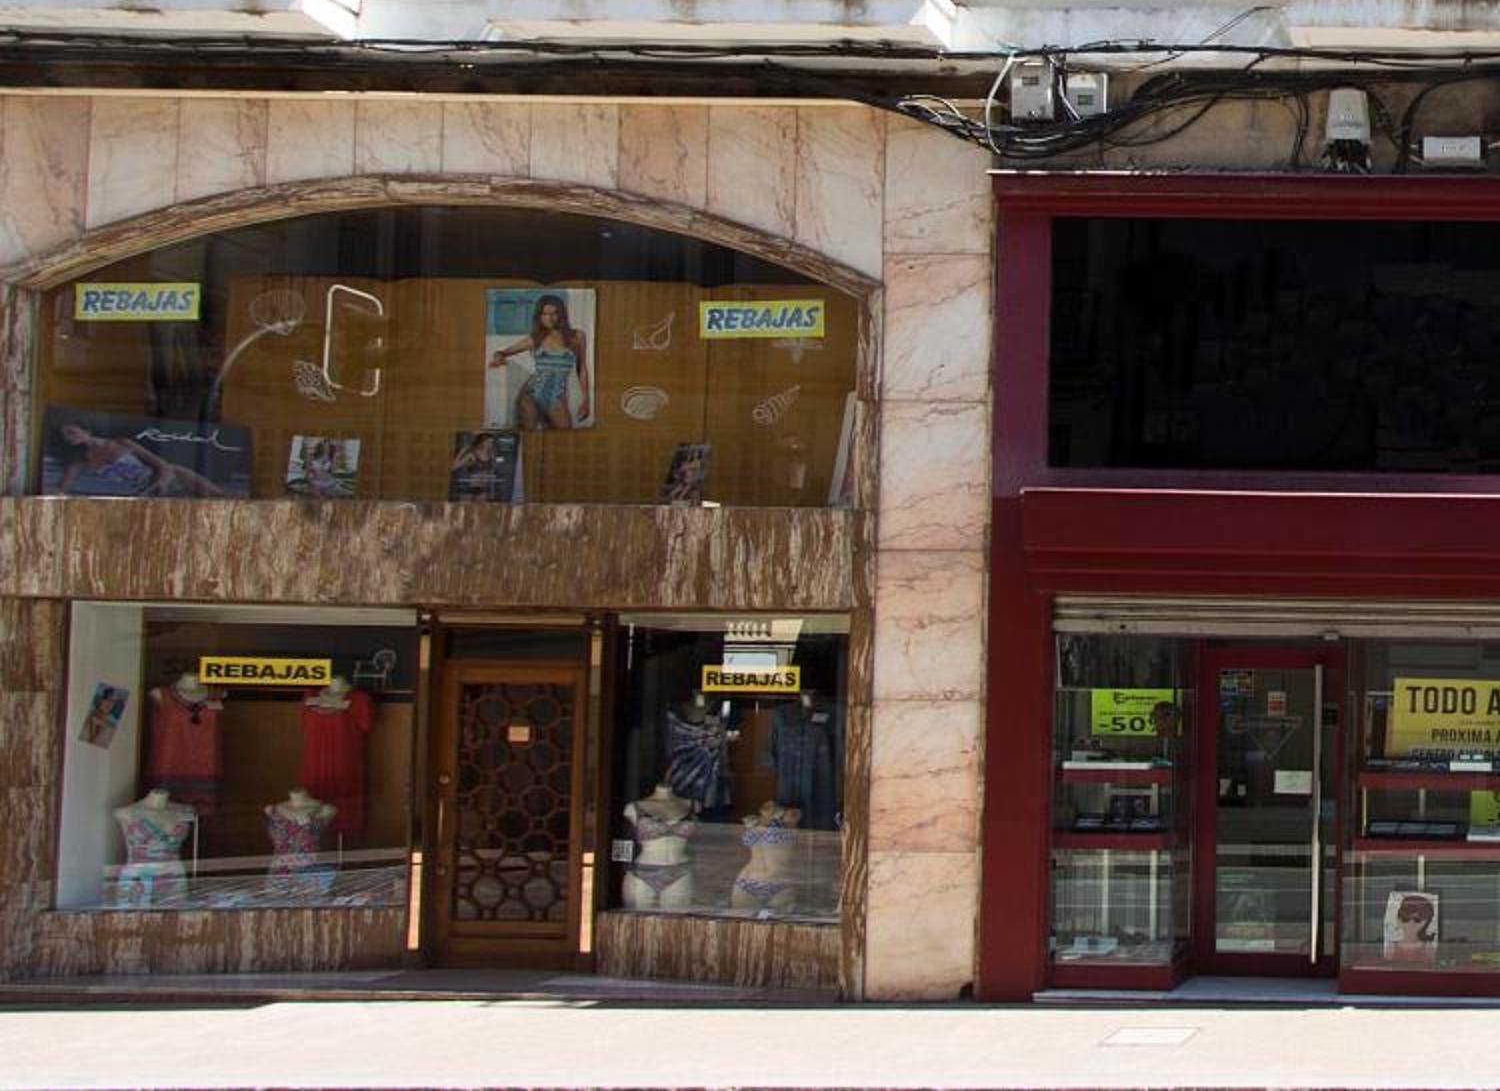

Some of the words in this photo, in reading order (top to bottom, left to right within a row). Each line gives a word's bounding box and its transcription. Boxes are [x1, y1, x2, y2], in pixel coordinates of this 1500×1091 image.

[83, 289, 194, 313] REBAJAS
[706, 306, 819, 330] REBAJAS
[205, 662, 327, 680] REBAJAS
[705, 671, 797, 687] REBAJAS
[1405, 685, 1477, 715] TODO
